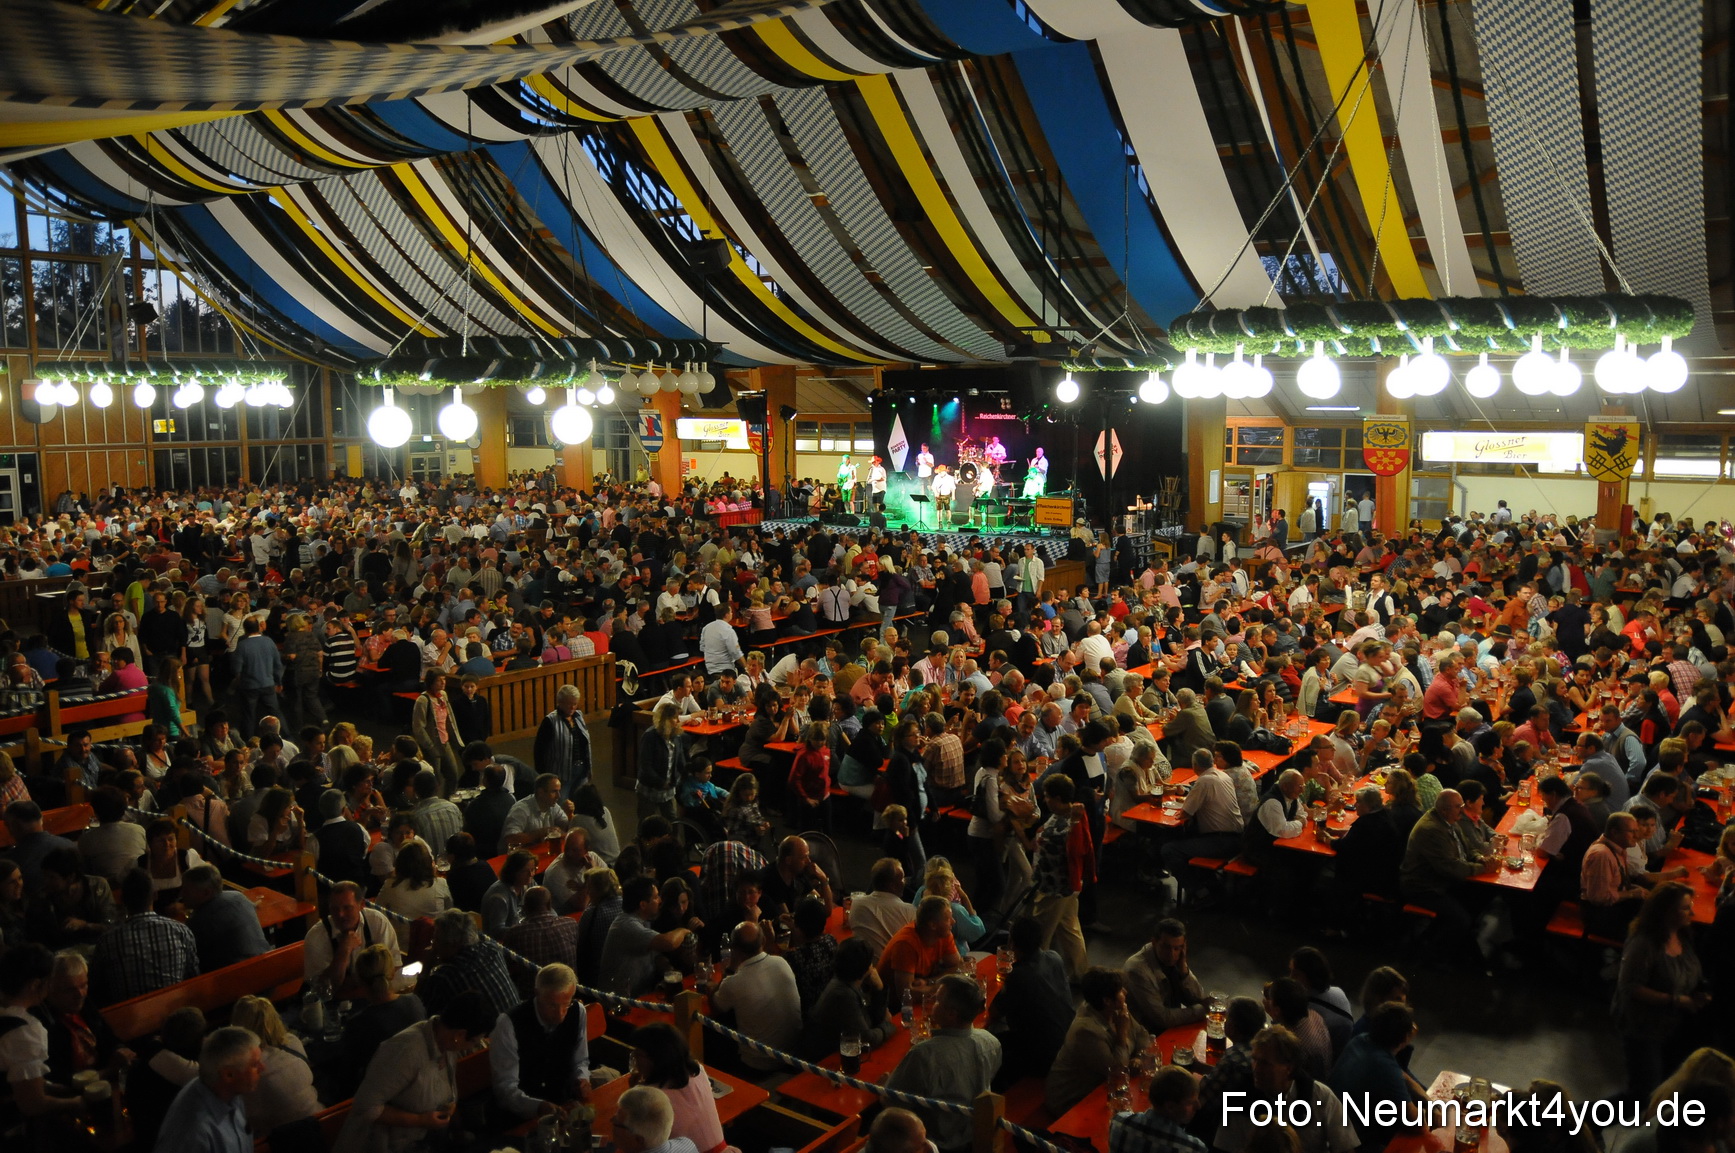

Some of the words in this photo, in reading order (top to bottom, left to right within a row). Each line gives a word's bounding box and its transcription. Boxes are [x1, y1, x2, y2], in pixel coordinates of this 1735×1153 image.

[892, 443, 906, 455] PARTY
[1474, 436, 1528, 459] Glossner
[1503, 449, 1528, 459] Bier
